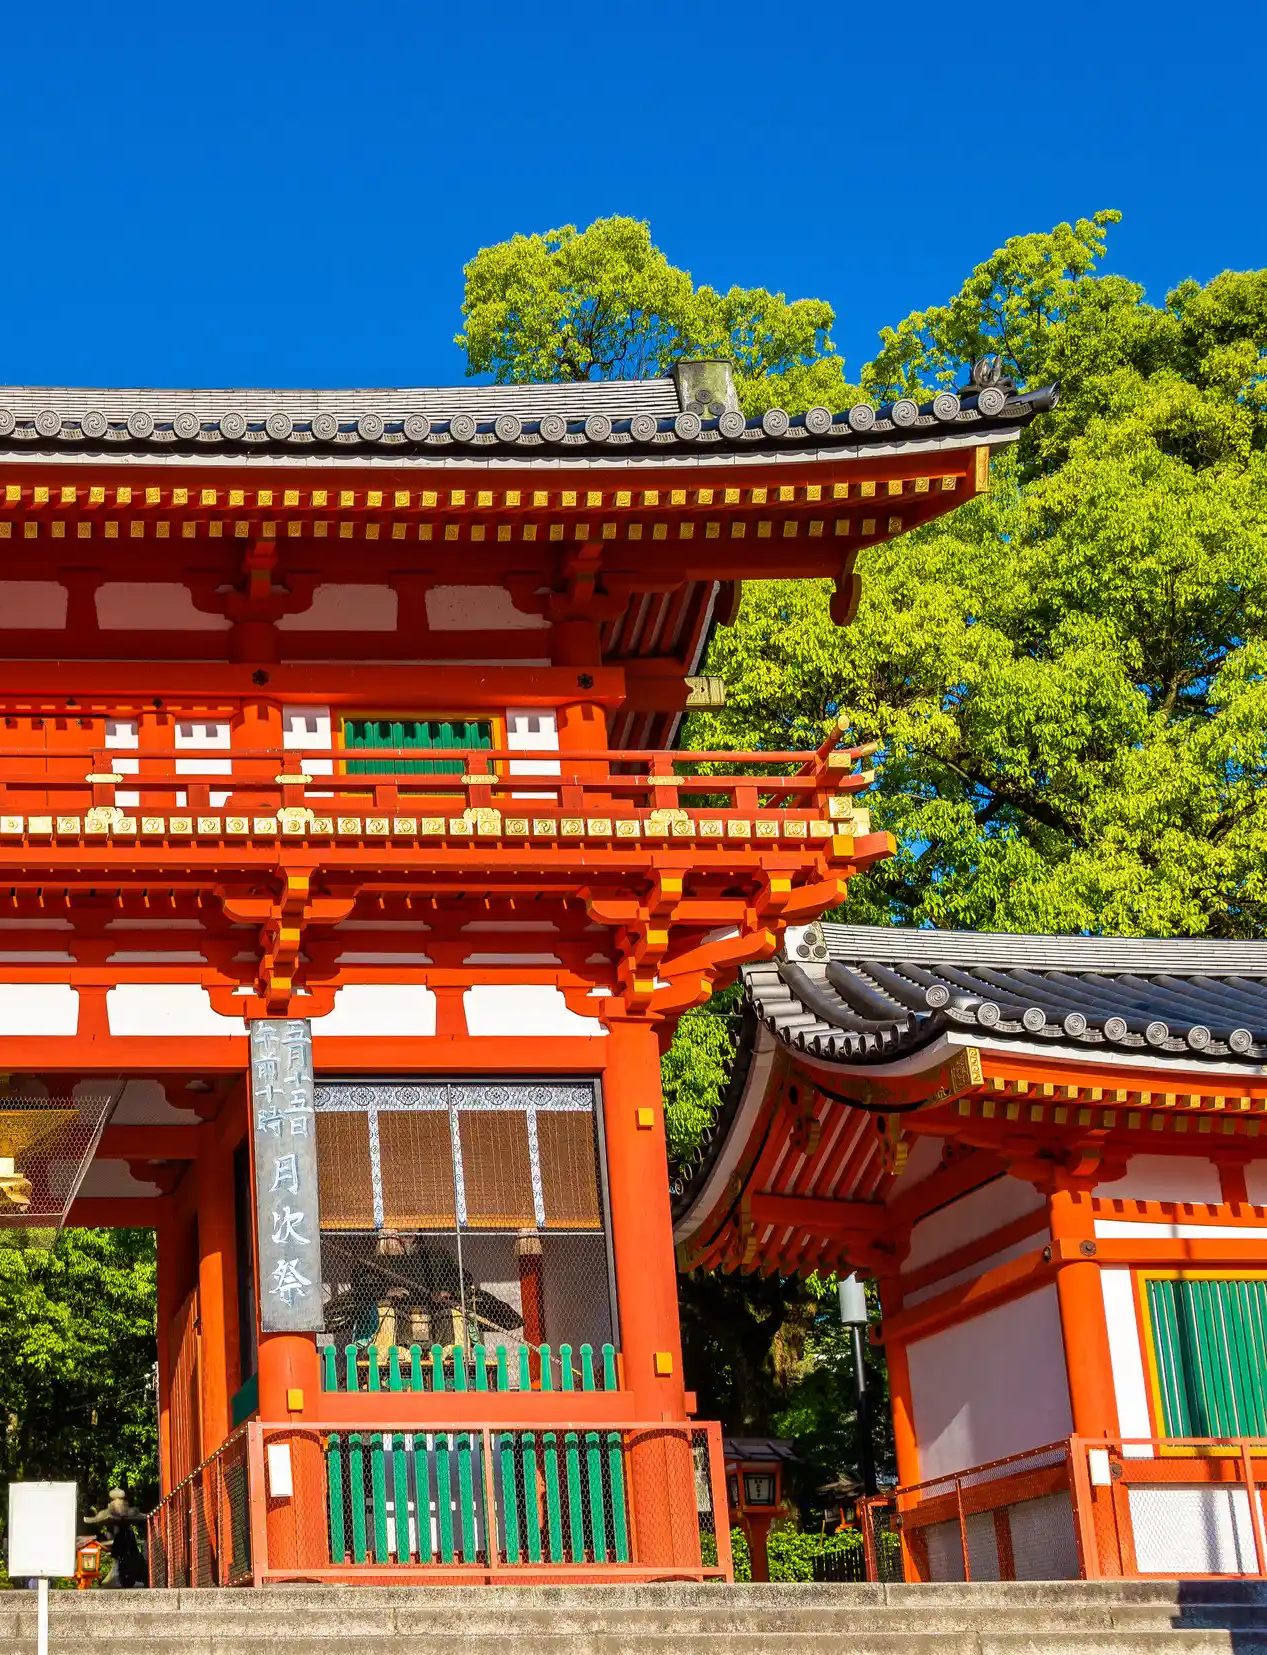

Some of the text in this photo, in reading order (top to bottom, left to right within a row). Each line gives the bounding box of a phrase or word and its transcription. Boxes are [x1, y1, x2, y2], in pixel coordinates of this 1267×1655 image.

[253, 1021, 285, 1138] 午前十時
[280, 1020, 315, 1138] 五月十五日
[268, 1152, 311, 1308] 月次祭
